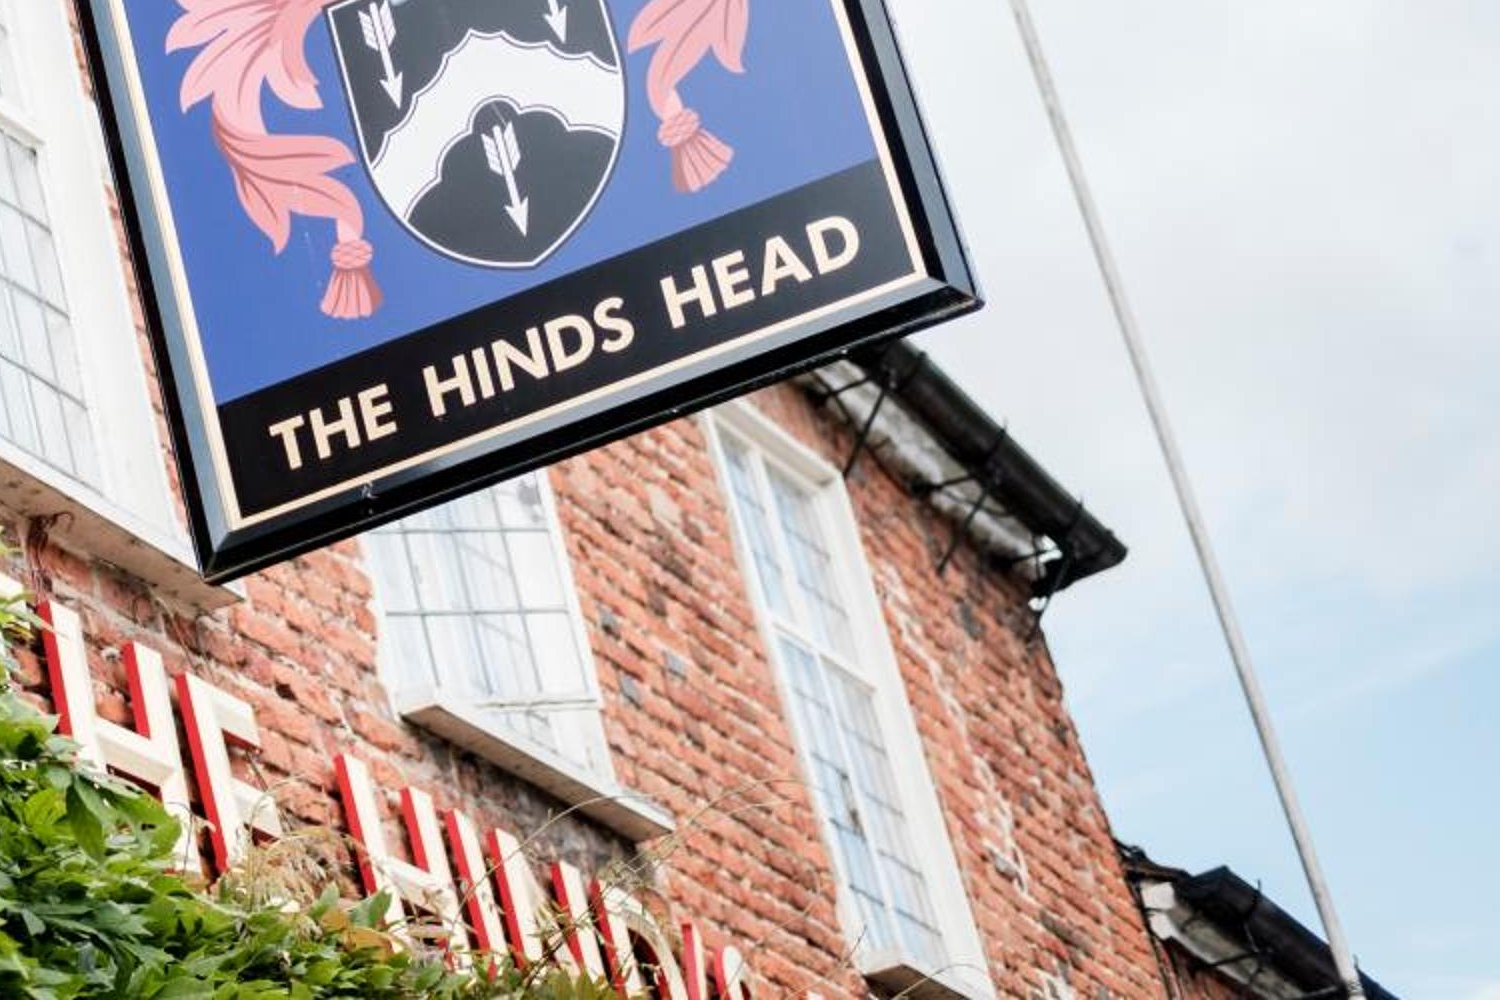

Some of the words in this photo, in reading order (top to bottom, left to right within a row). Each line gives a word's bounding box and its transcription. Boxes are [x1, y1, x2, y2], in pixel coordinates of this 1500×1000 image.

[269, 383, 396, 470] THE
[423, 297, 634, 416] HINDS
[660, 215, 860, 329] HEAD
